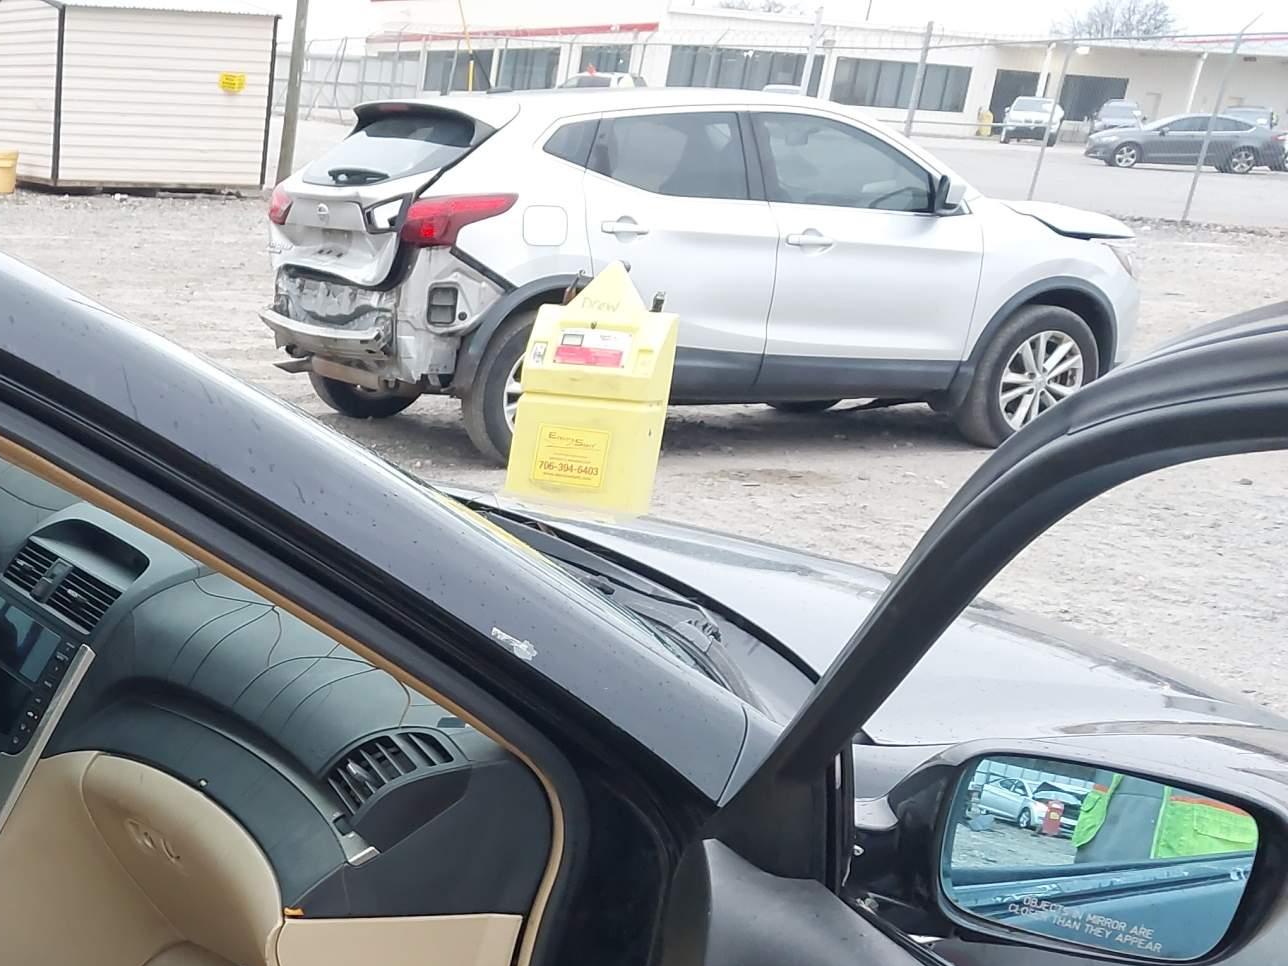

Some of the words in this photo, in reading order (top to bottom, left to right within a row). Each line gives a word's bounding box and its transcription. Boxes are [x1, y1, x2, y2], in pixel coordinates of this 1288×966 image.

[539, 461, 599, 476] 706-394-6403
[1052, 915, 1081, 931] THAN
[1085, 923, 1112, 939] THEY
[1115, 933, 1162, 953] APPEAR
[1086, 913, 1127, 932] MIRROR
[1129, 926, 1155, 940] ARE
